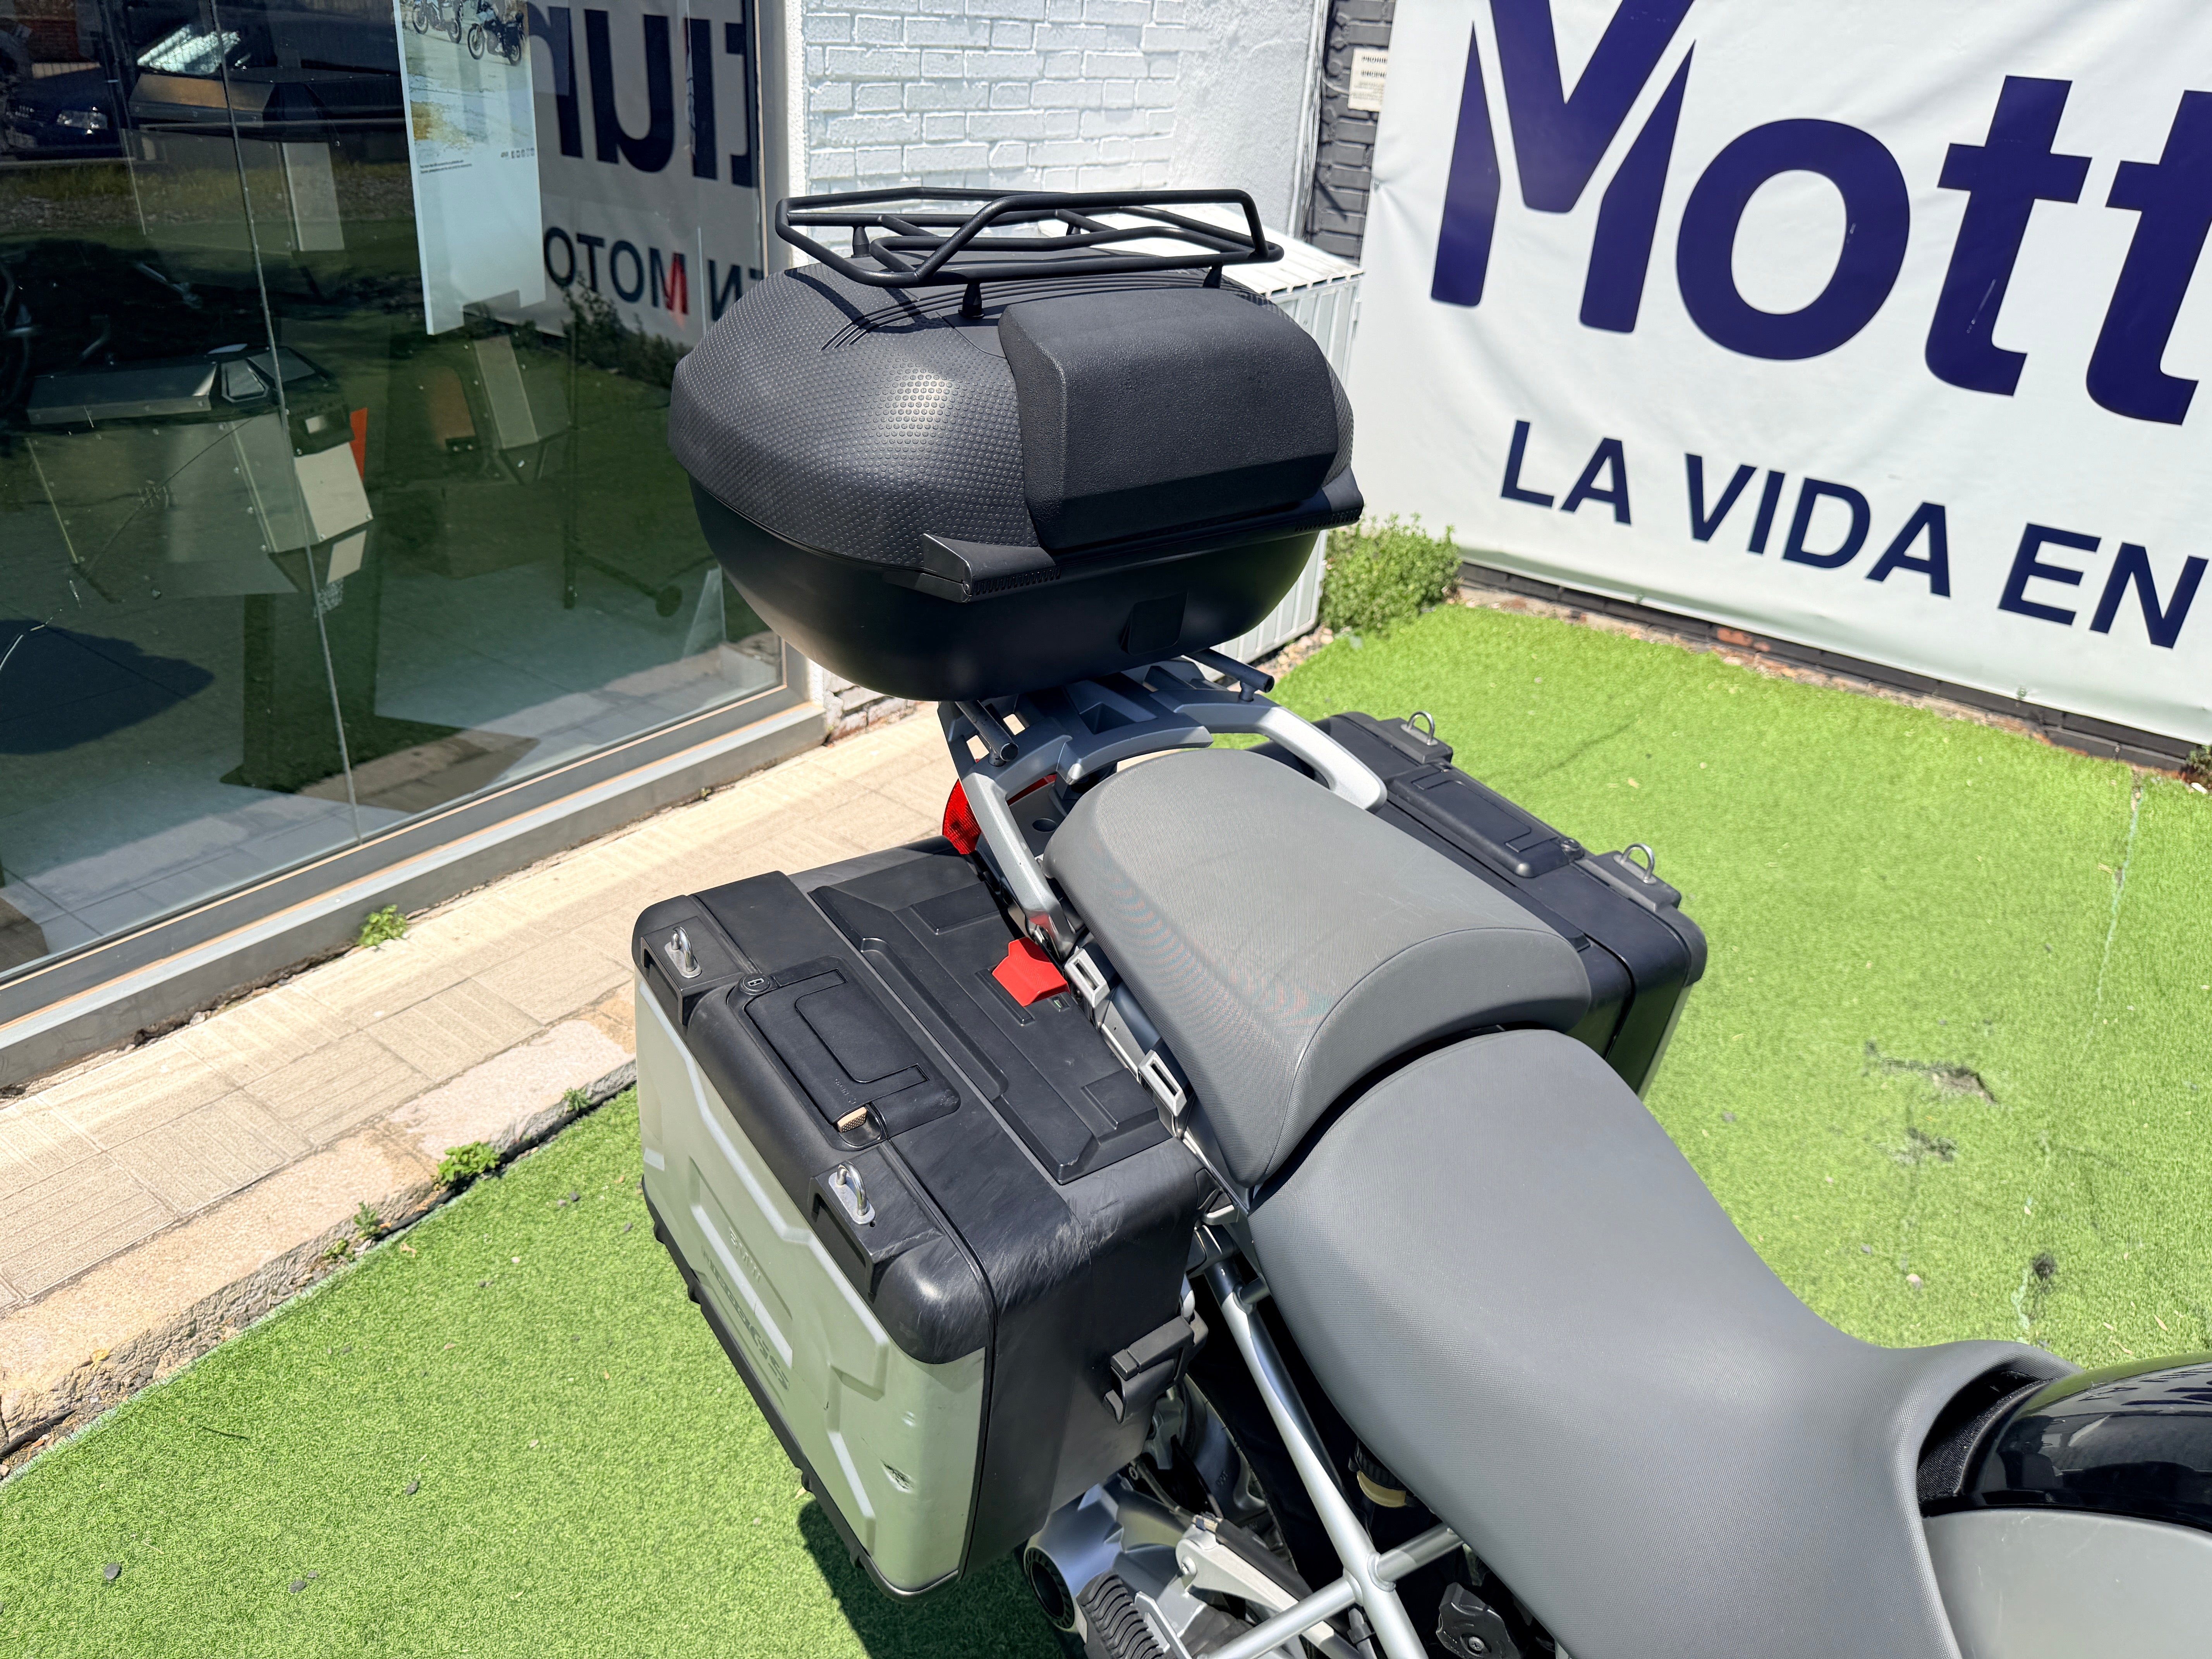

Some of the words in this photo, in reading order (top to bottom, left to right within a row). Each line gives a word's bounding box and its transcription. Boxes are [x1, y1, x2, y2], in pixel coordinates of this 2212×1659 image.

[1431, 0, 2212, 425] Mott
[1501, 420, 1631, 525] LA
[1685, 453, 1950, 598] VIDA
[1998, 523, 2209, 649] EN
